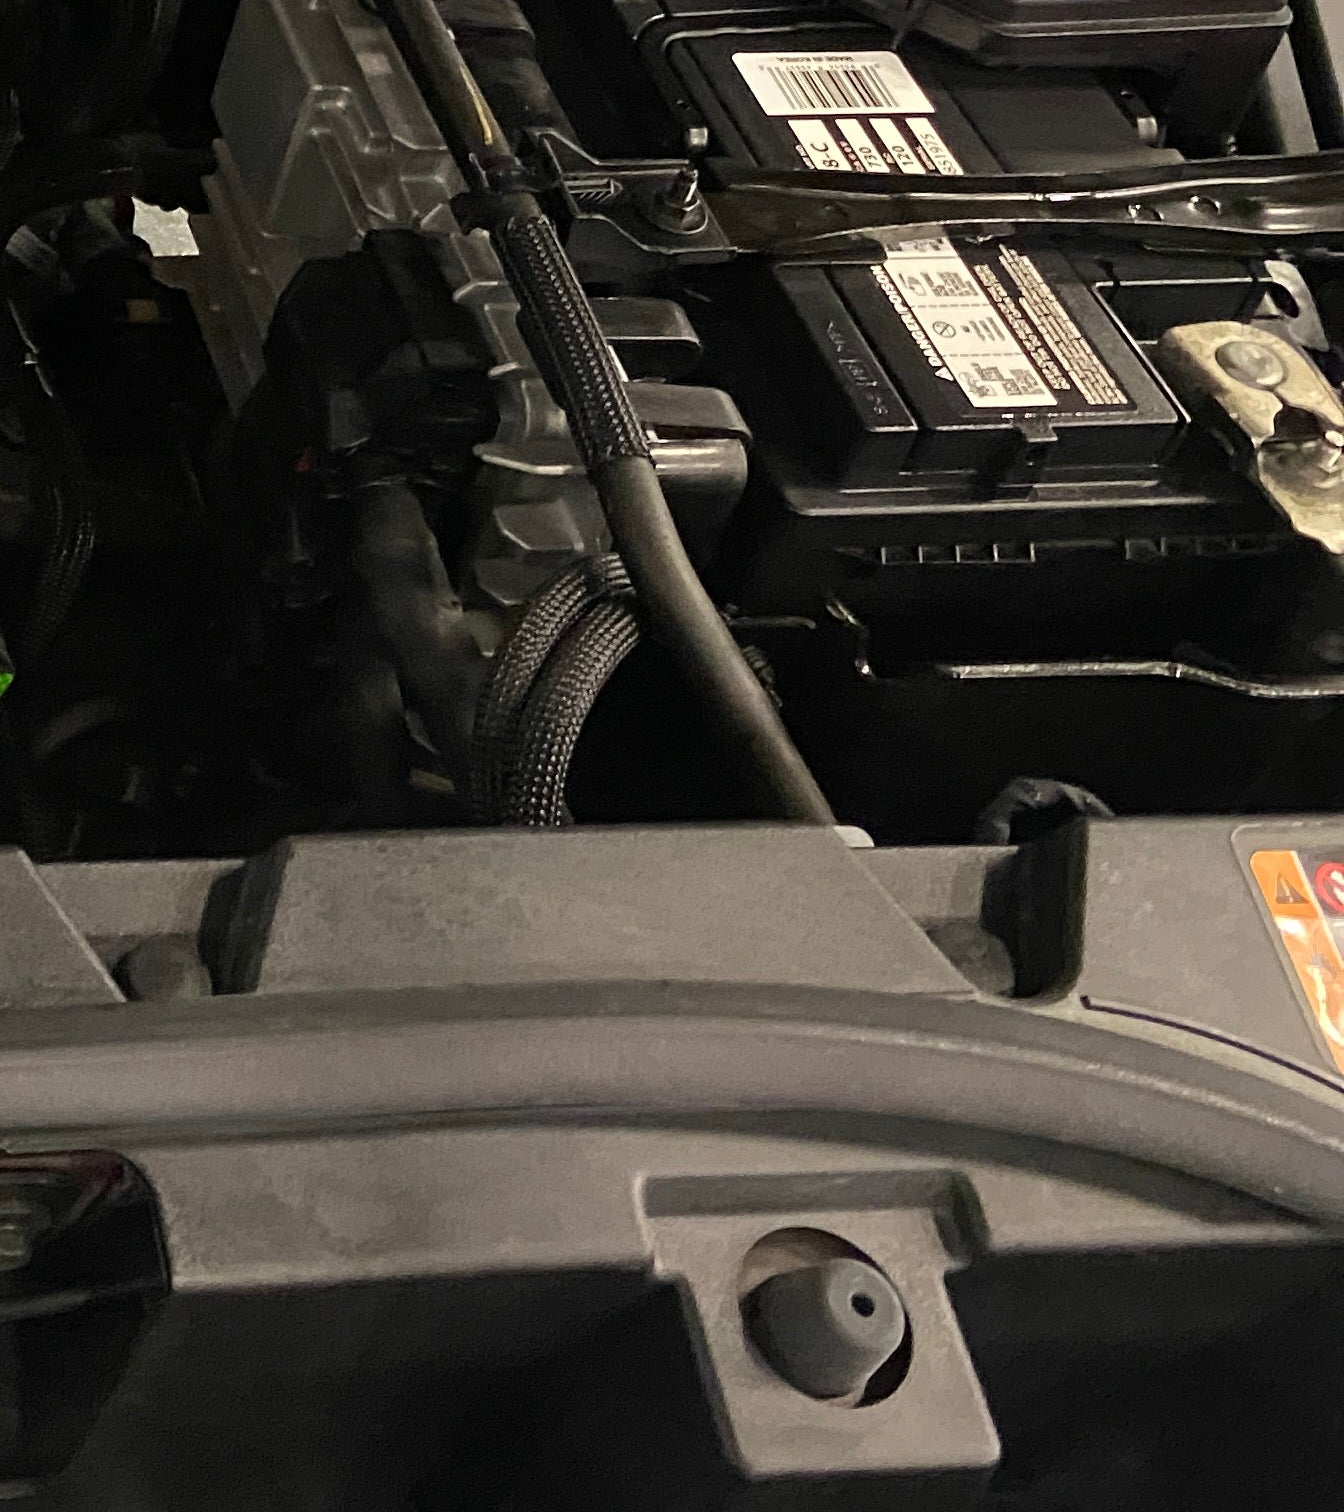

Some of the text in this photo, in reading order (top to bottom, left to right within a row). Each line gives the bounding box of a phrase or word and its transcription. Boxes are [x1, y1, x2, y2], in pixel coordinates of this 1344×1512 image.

[859, 146, 882, 168] 730
[892, 145, 914, 166] 120
[870, 264, 944, 367] DANGER/POISON
